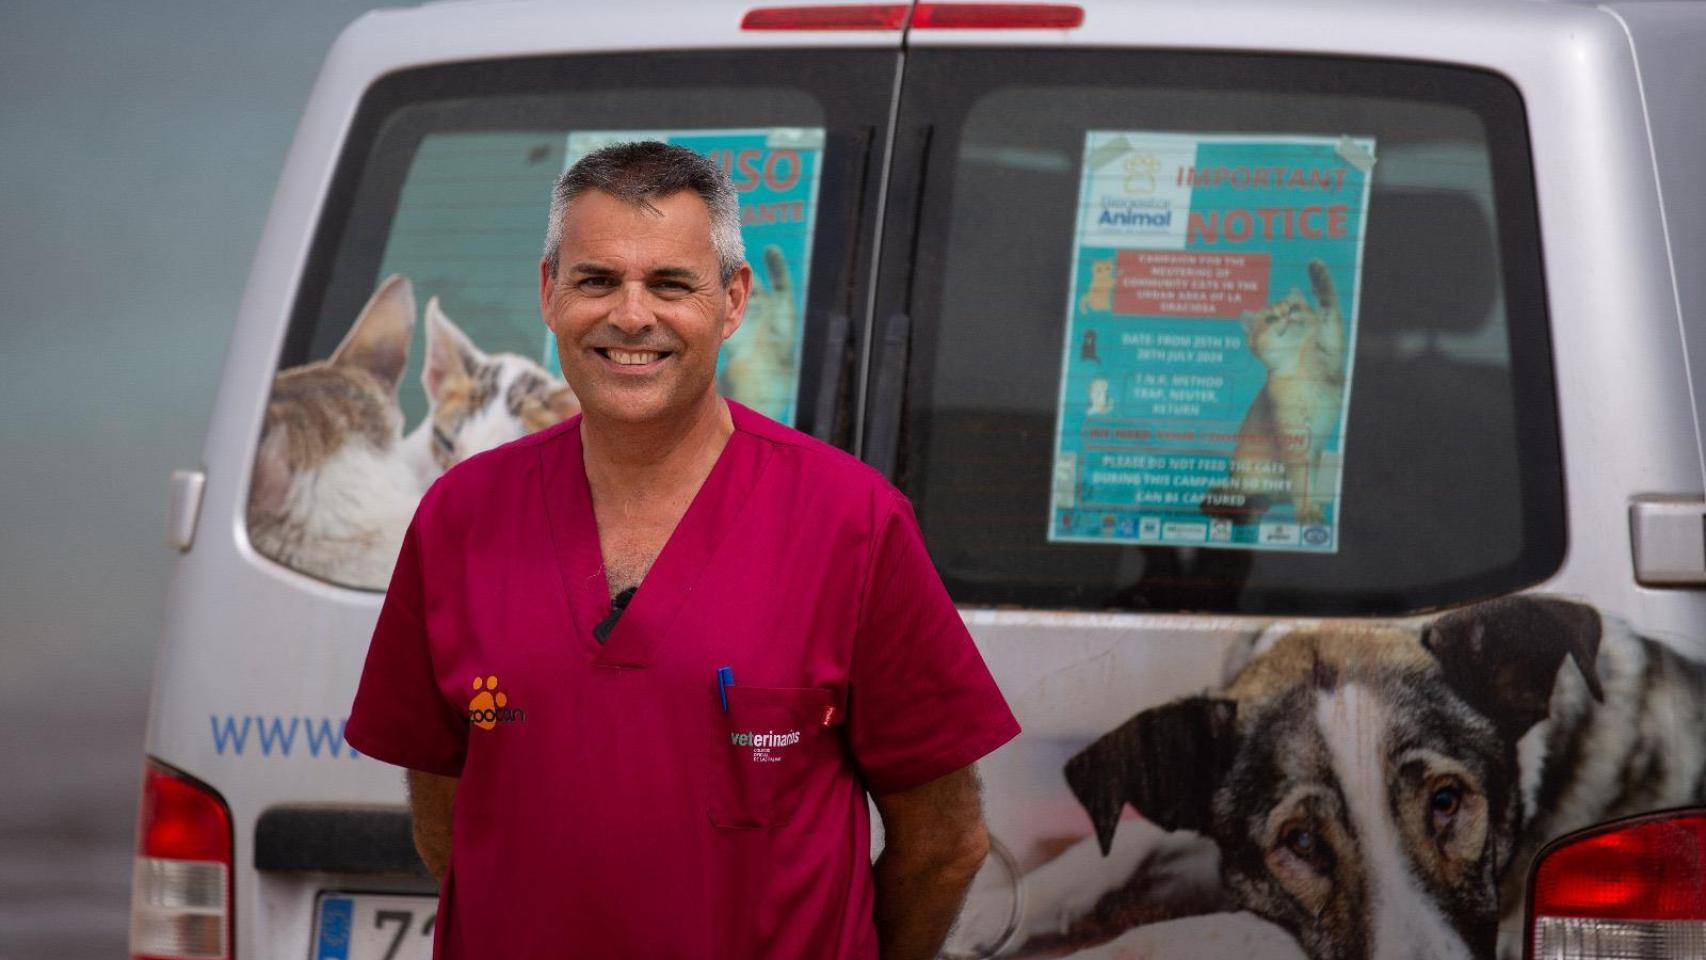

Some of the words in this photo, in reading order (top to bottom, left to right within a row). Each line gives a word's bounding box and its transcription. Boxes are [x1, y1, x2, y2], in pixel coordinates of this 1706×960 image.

[711, 149, 800, 192] ISO
[1176, 166, 1348, 191] IMPORTANT
[1098, 209, 1172, 226] Animal
[1187, 205, 1348, 244] NOTICE
[1224, 257, 1246, 267] THE
[1157, 334, 1192, 347] FROM
[1224, 337, 1241, 350] TO
[1172, 375, 1223, 388] METHOD
[1152, 403, 1200, 416] RETURN
[1102, 456, 1149, 470] PLEASE
[1149, 458, 1166, 470] DO
[1169, 458, 1195, 471] NOT
[1198, 459, 1226, 472] FEED
[1229, 460, 1250, 473] THE
[1092, 471, 1142, 485] DURING
[1145, 473, 1170, 486] THIS
[1173, 474, 1239, 489] CAMPAIGN
[1260, 478, 1292, 492] THEY
[1136, 491, 1161, 503] CAN
[1165, 492, 1179, 503] BE
[1183, 492, 1246, 507] CAPTURED
[211, 715, 359, 758] www.
